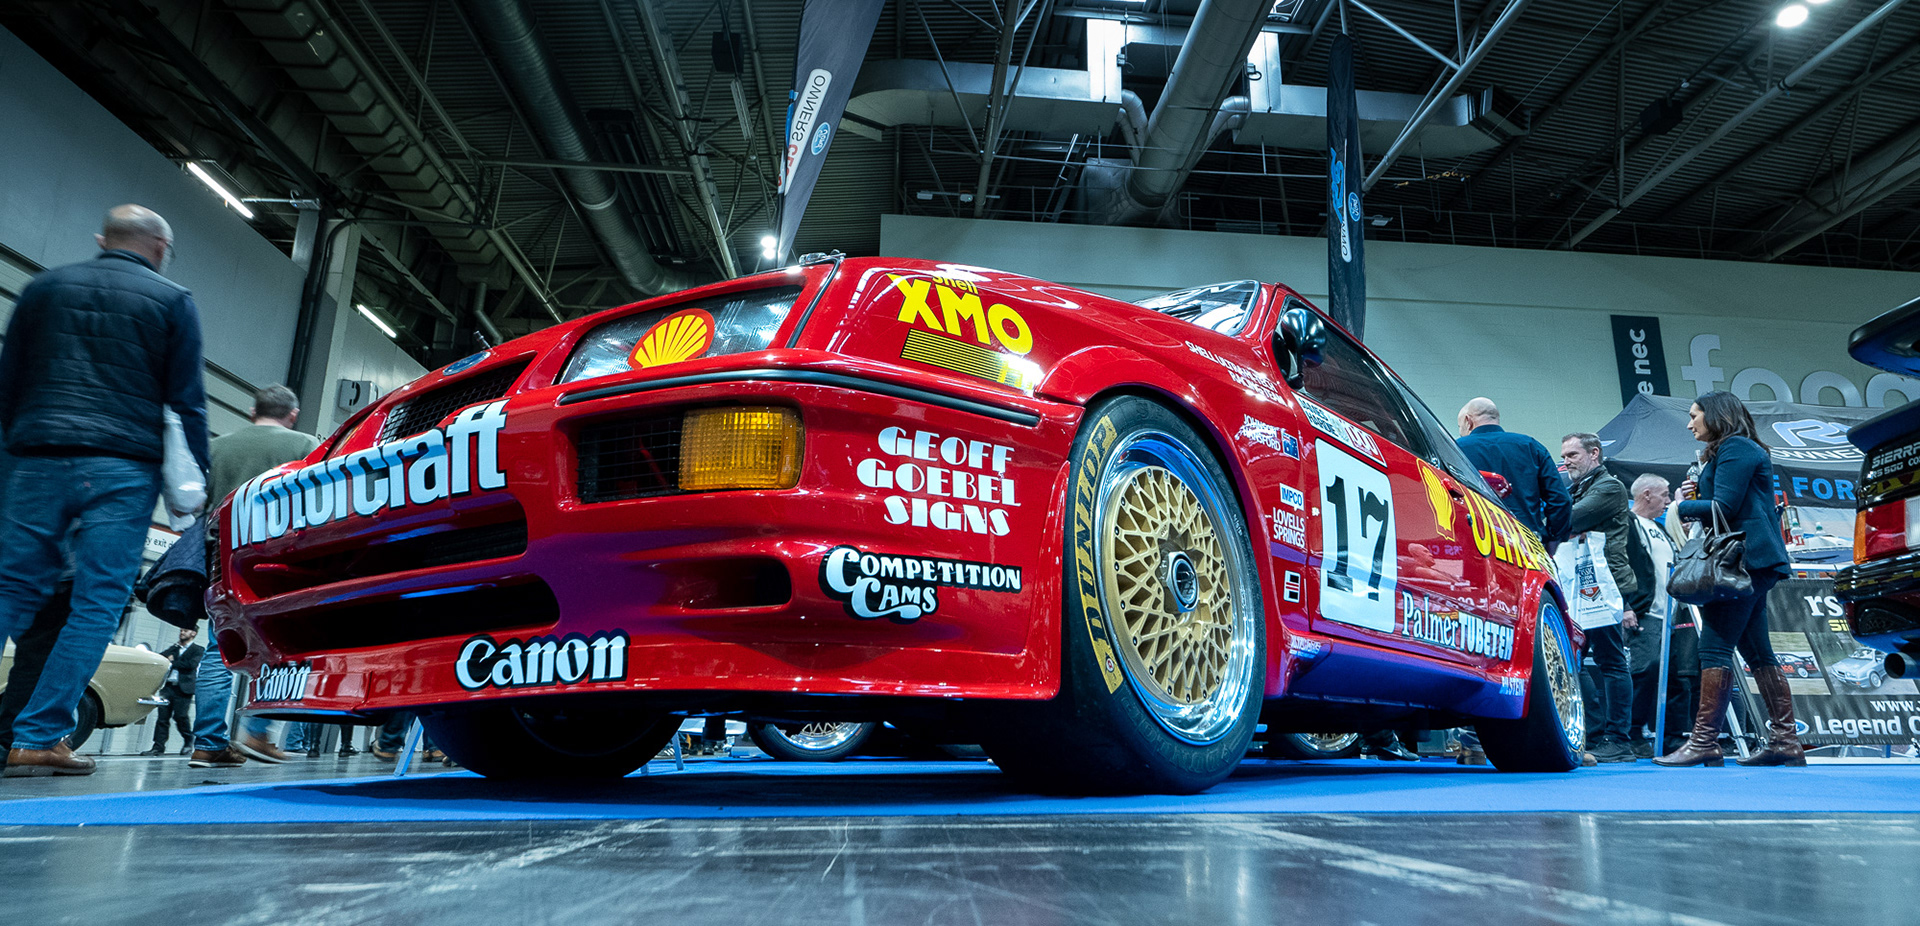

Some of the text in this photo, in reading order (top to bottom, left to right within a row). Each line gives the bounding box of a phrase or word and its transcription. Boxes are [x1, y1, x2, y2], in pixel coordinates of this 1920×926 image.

[886, 273, 1034, 355] XMO
[878, 426, 1015, 473] GEOFF
[231, 398, 511, 550] Motorcraft
[857, 458, 1021, 507] GOEBEL
[1792, 476, 1857, 501] FOR
[884, 495, 1010, 536] SIGNS
[1281, 487, 1303, 506] IMPCO
[1077, 422, 1110, 645] DUNLOP
[1273, 507, 1305, 532] LOVELLS
[1273, 524, 1305, 548] SPRINGS
[1325, 474, 1389, 602] 17
[826, 548, 1020, 593] COMPETITION
[851, 576, 937, 619] CAMS
[256, 664, 311, 700] Canon
[456, 635, 625, 689] Canon
[1814, 715, 1902, 738] Legend
